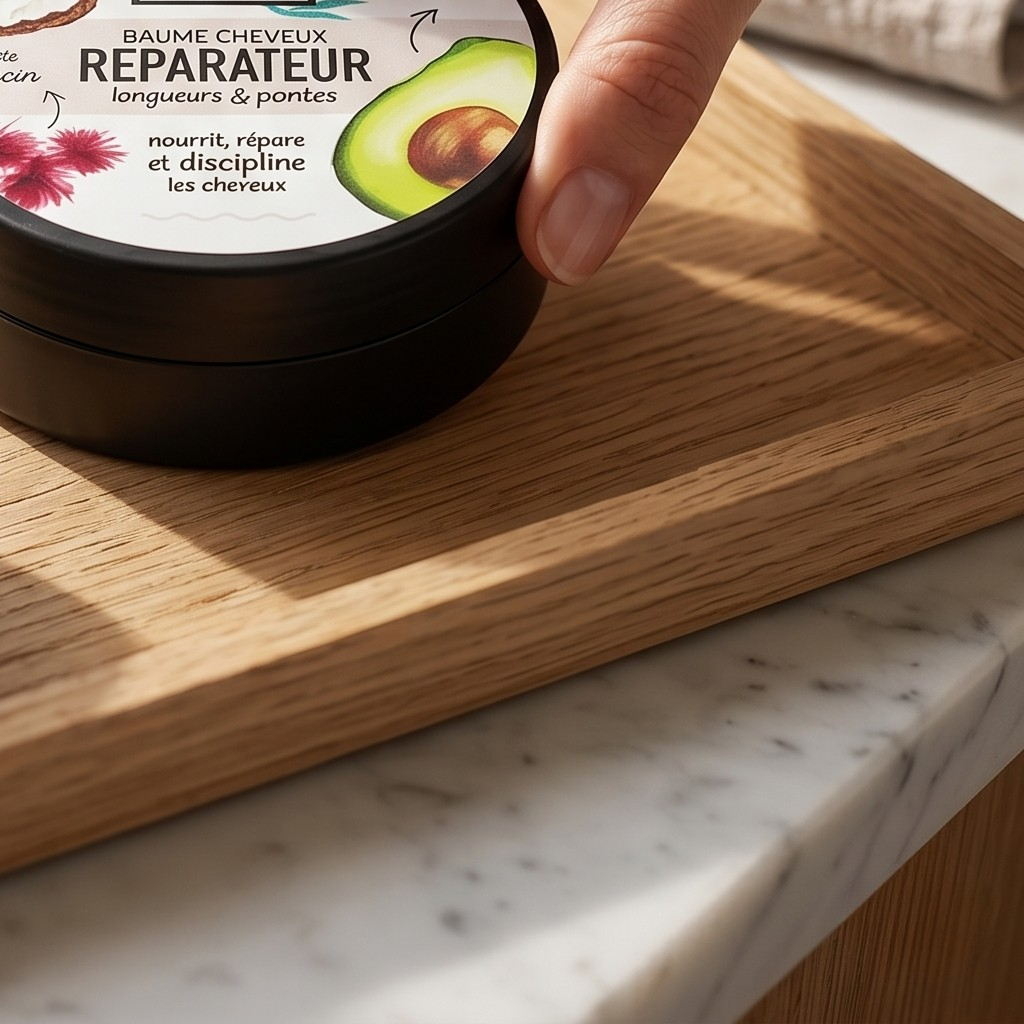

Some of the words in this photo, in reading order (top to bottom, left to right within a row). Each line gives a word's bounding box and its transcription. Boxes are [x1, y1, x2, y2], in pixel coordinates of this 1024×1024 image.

[123, 29, 208, 43] BAUME
[216, 29, 327, 43] CHEVEUX
[79, 48, 372, 82] REPARATEUR
[112, 86, 222, 109] longueurs
[230, 87, 250, 104] &
[257, 88, 337, 108] pontes
[148, 132, 230, 150] nourrit,
[237, 131, 305, 152] répare
[148, 155, 170, 171] et
[179, 151, 305, 178] discipline
[168, 177, 195, 192] les
